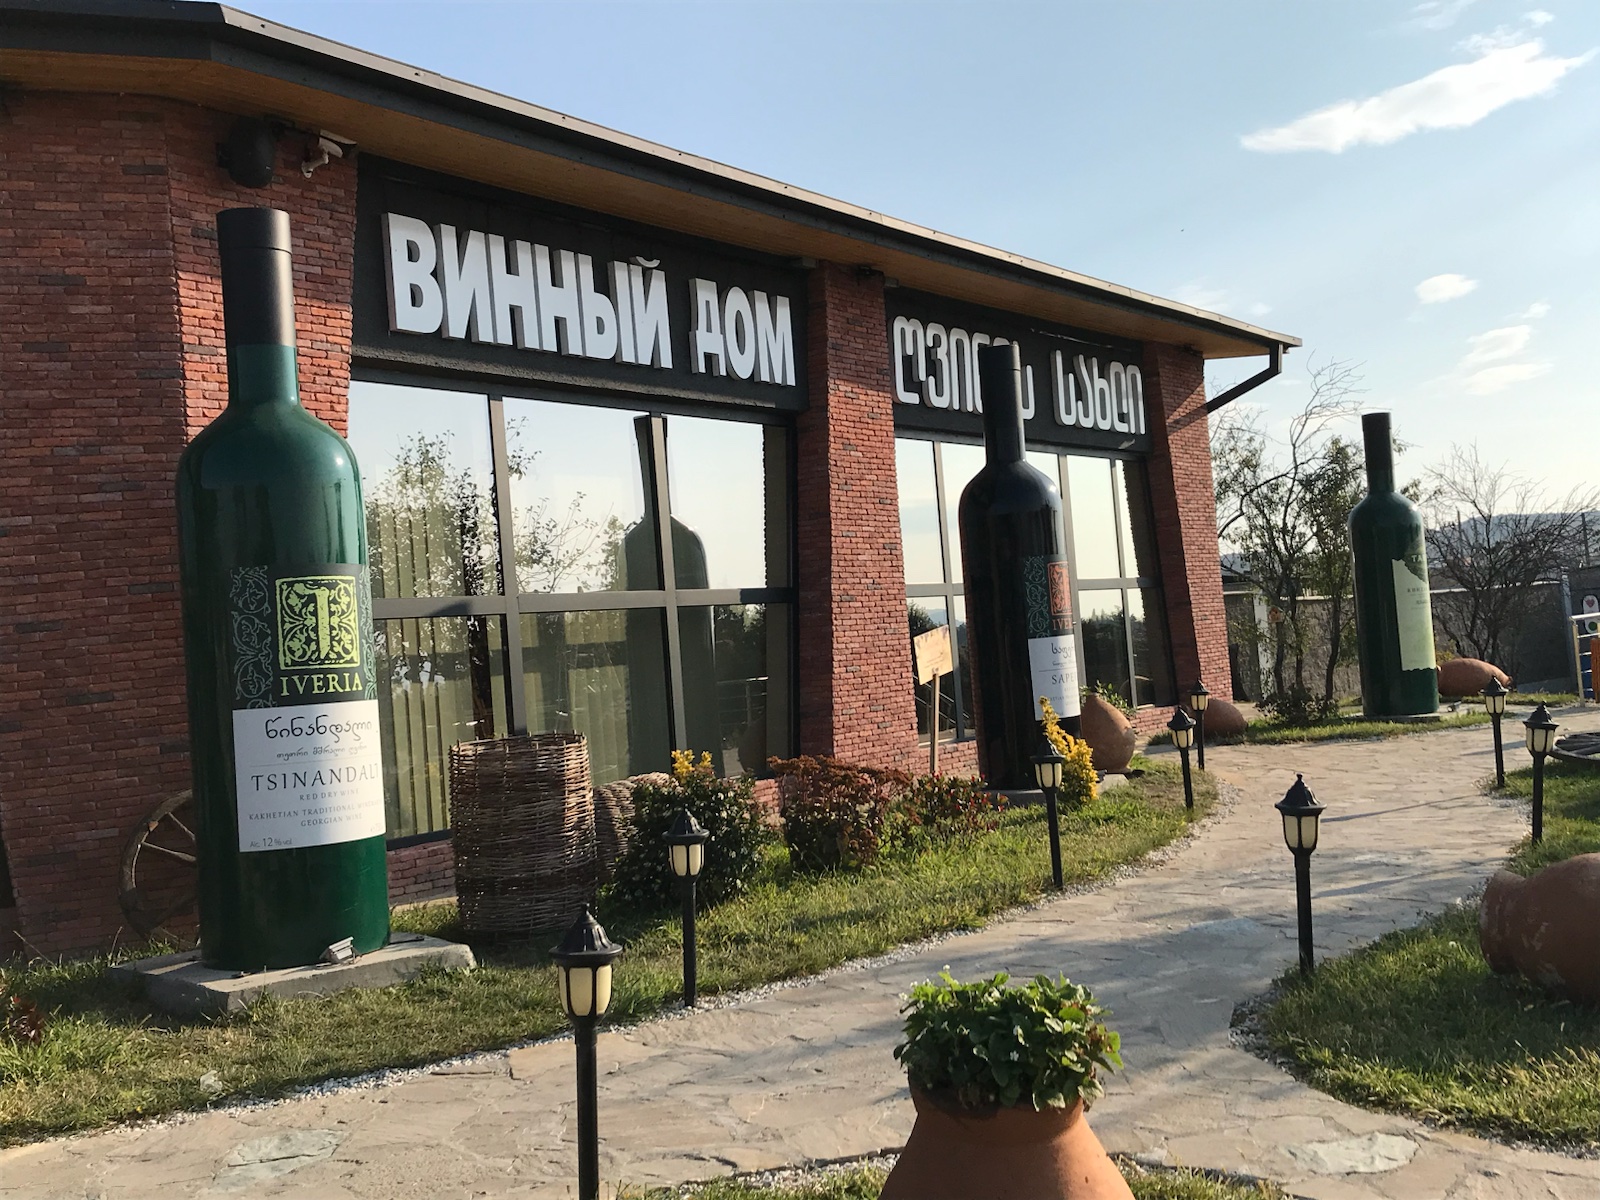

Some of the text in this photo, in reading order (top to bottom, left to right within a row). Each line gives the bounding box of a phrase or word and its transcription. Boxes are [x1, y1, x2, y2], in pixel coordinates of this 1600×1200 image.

[381, 212, 796, 387] ВИННЫЙ ДОМ
[1051, 349, 1146, 435] სახლი
[279, 672, 363, 697] IVERIA
[264, 714, 372, 743] წინანდალი
[250, 762, 379, 791] TSINANDALI
[299, 793, 318, 801] RED
[321, 790, 337, 799] DRY
[248, 809, 299, 821] KAKHETIAN
[301, 803, 356, 816] TRADITIONAL
[300, 815, 343, 828] GEORGIAN
